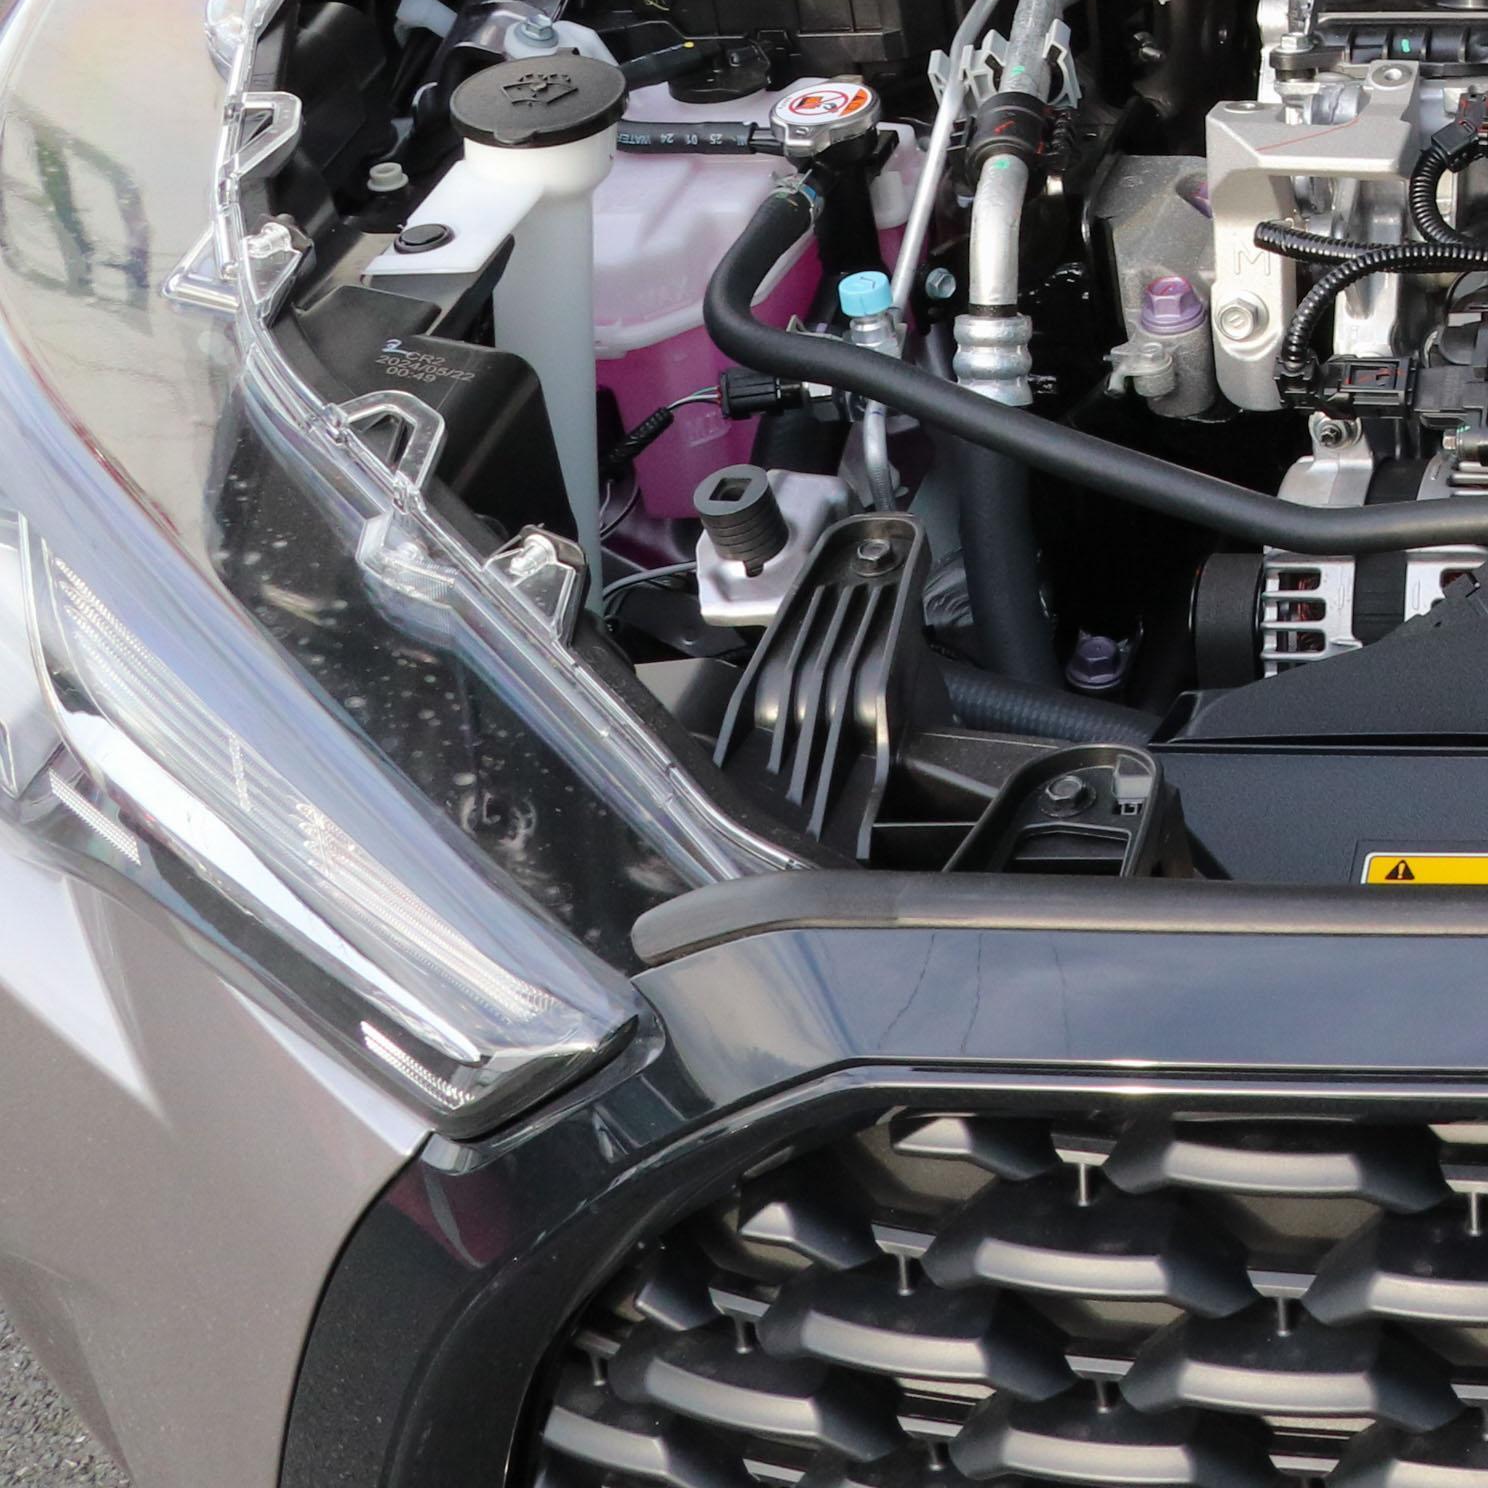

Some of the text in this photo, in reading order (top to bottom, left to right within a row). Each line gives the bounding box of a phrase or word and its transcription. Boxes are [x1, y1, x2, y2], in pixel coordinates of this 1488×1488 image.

[660, 133, 675, 144] 24
[375, 355, 476, 382] 2024/05/22
[385, 366, 438, 384] 00:49
